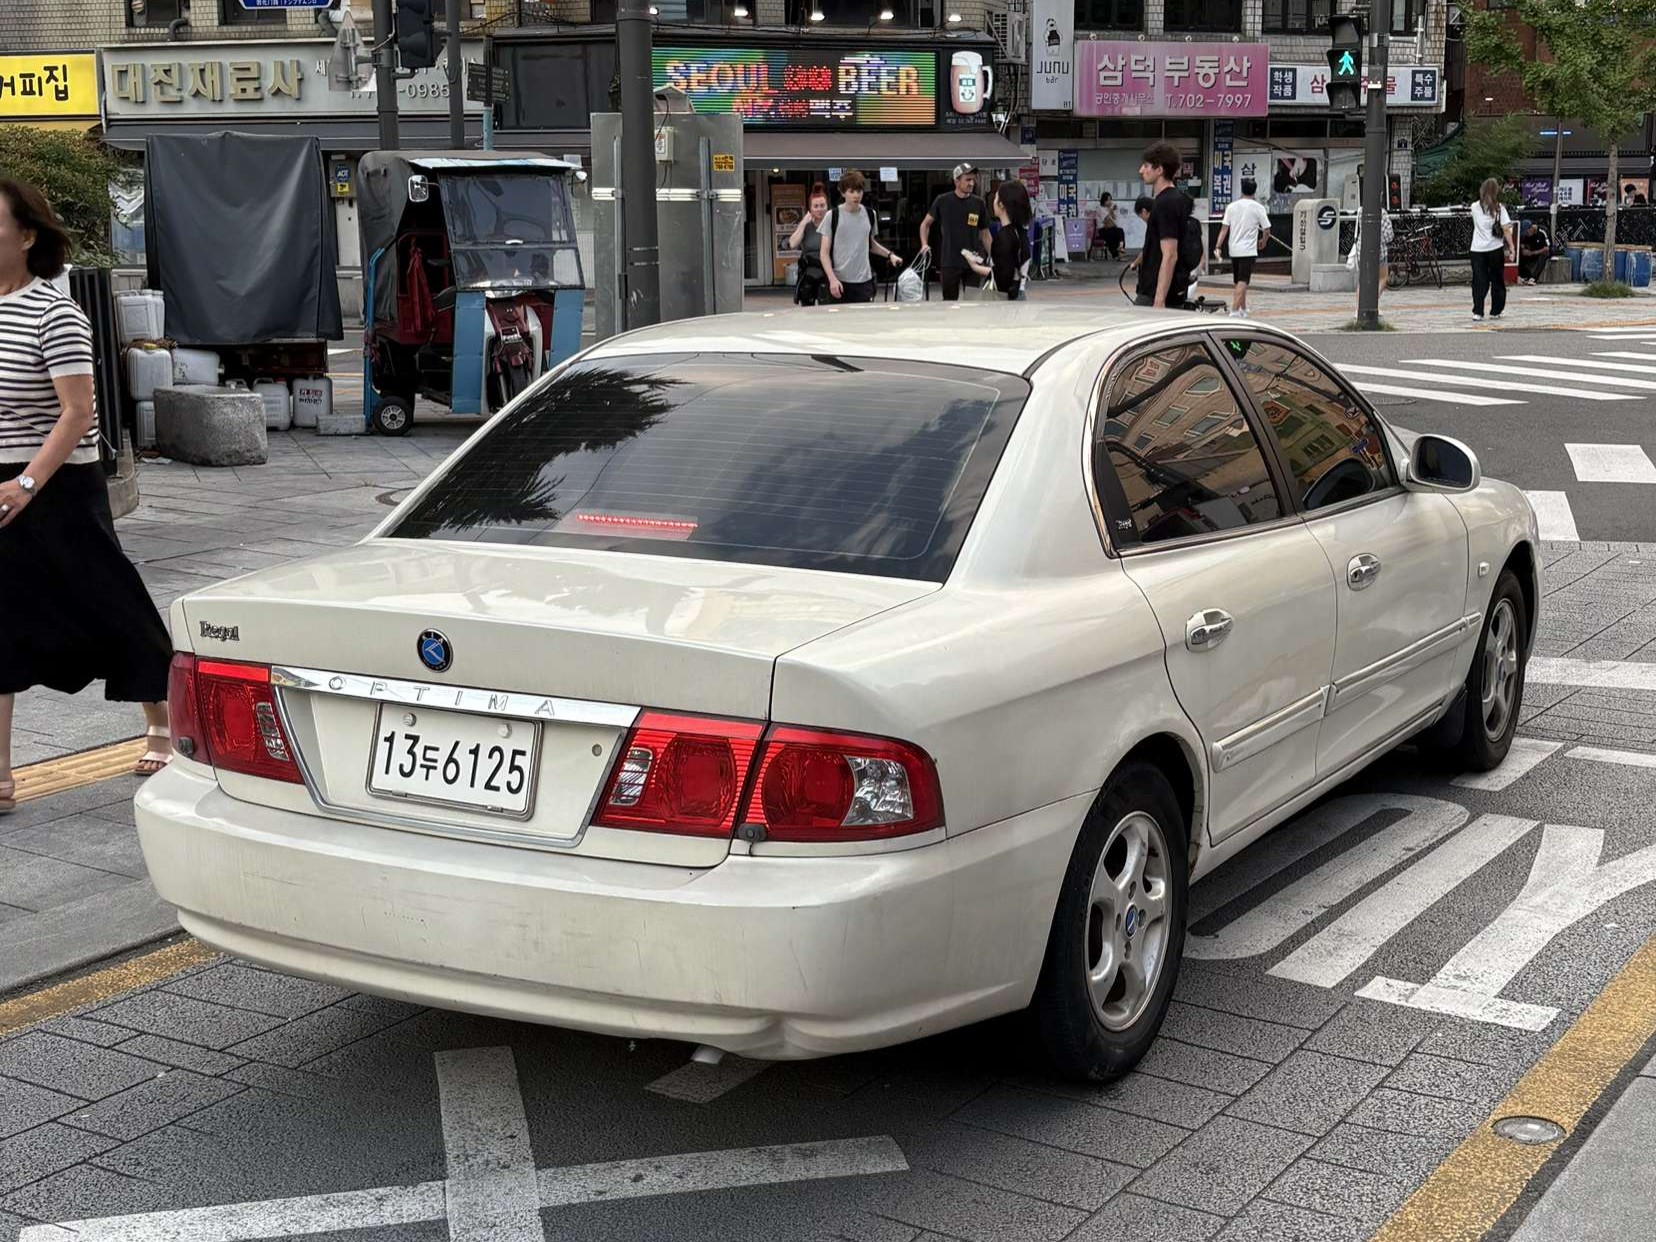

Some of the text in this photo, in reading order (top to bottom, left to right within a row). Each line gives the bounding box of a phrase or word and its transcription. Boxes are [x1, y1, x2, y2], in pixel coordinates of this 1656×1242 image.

[111, 59, 304, 104] 대진재료사
[665, 60, 778, 93] SEOUL
[838, 65, 918, 95] BEER
[1273, 71, 1293, 84] 학생
[1414, 73, 1433, 85] 특수
[1273, 84, 1293, 97] 작품
[1166, 94, 1252, 109] T.702-7997
[199, 620, 240, 641] Regal
[328, 676, 555, 717] OPTIMA
[383, 731, 527, 796] 13두6125
